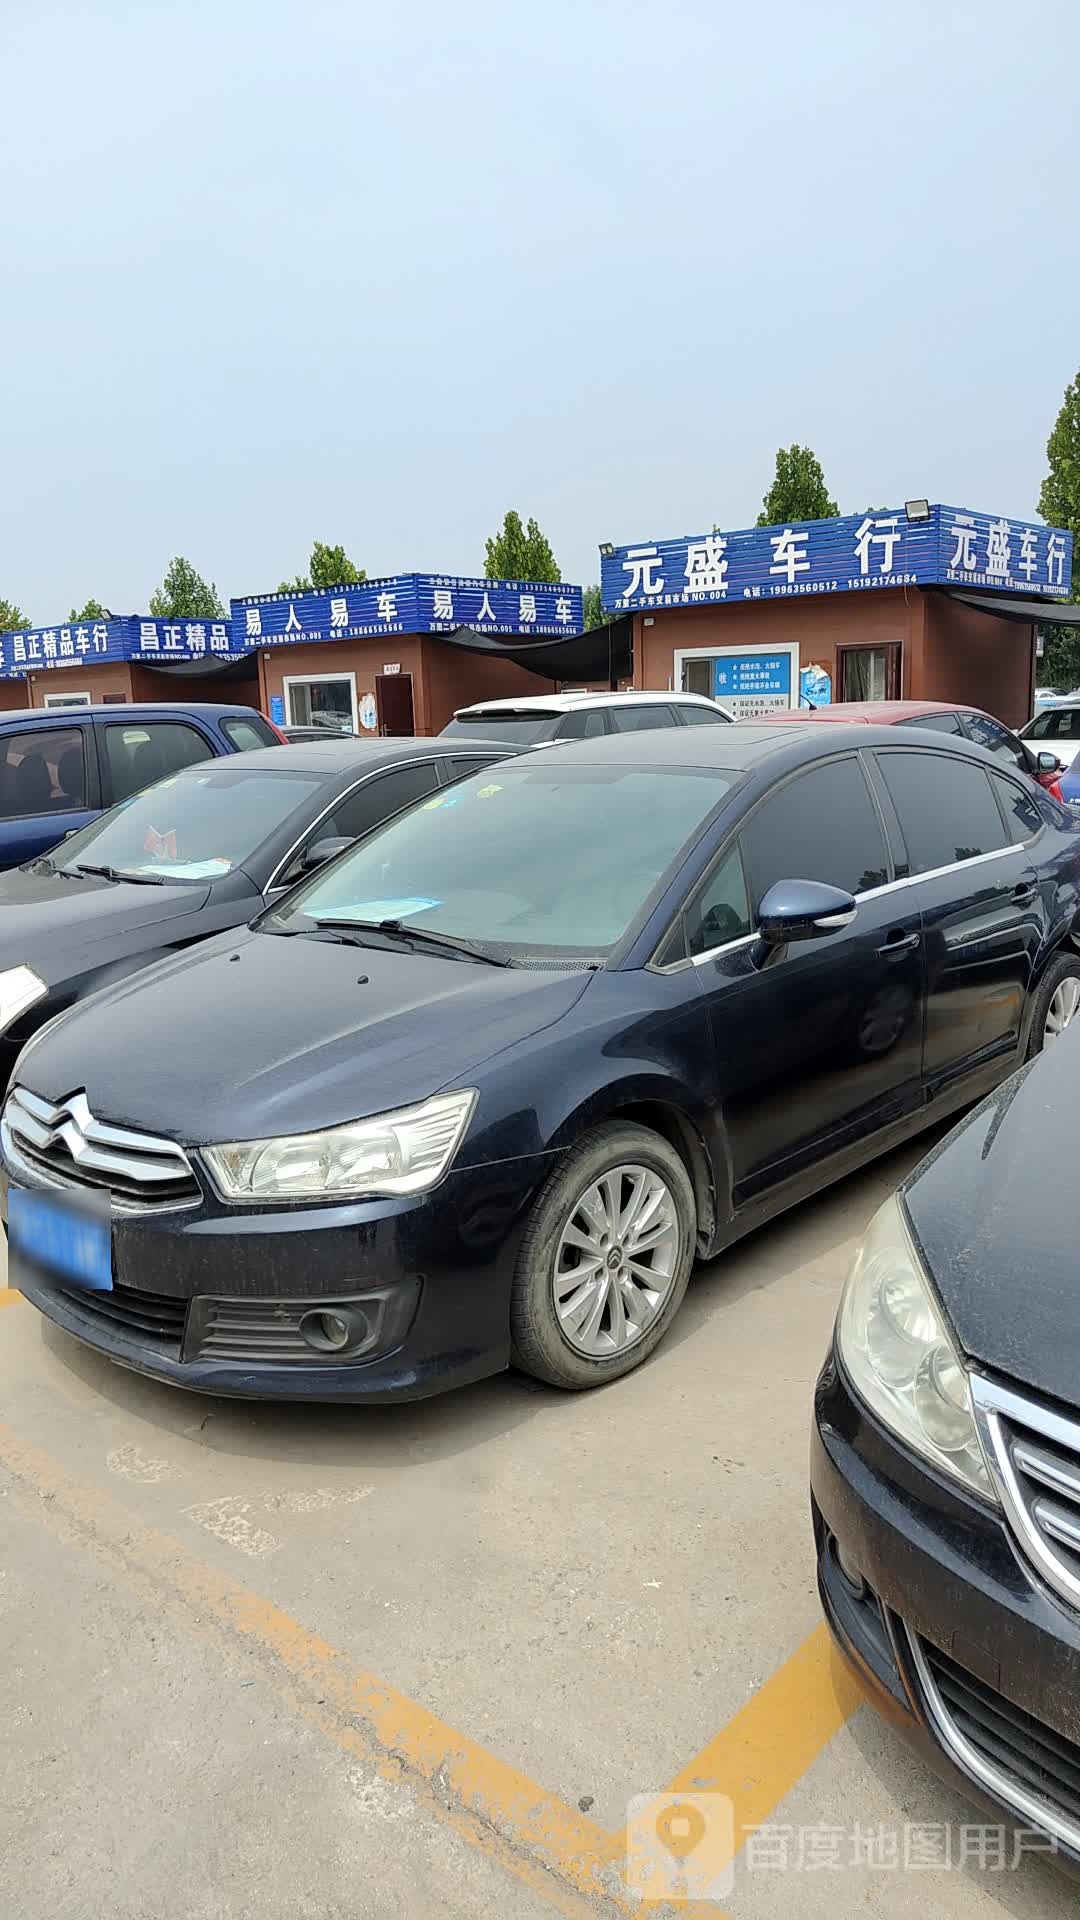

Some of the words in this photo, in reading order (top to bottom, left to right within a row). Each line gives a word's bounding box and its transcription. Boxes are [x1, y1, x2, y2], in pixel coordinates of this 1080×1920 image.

[621, 517, 901, 599] 元盛车行
[950, 514, 1066, 585] 元盛车行
[847, 574, 918, 588] 15192174684
[245, 591, 398, 636] 易人易车
[433, 589, 574, 625] 易人易车
[13, 623, 109, 662] 昌正精品车行
[140, 622, 230, 651] 昌正精品
